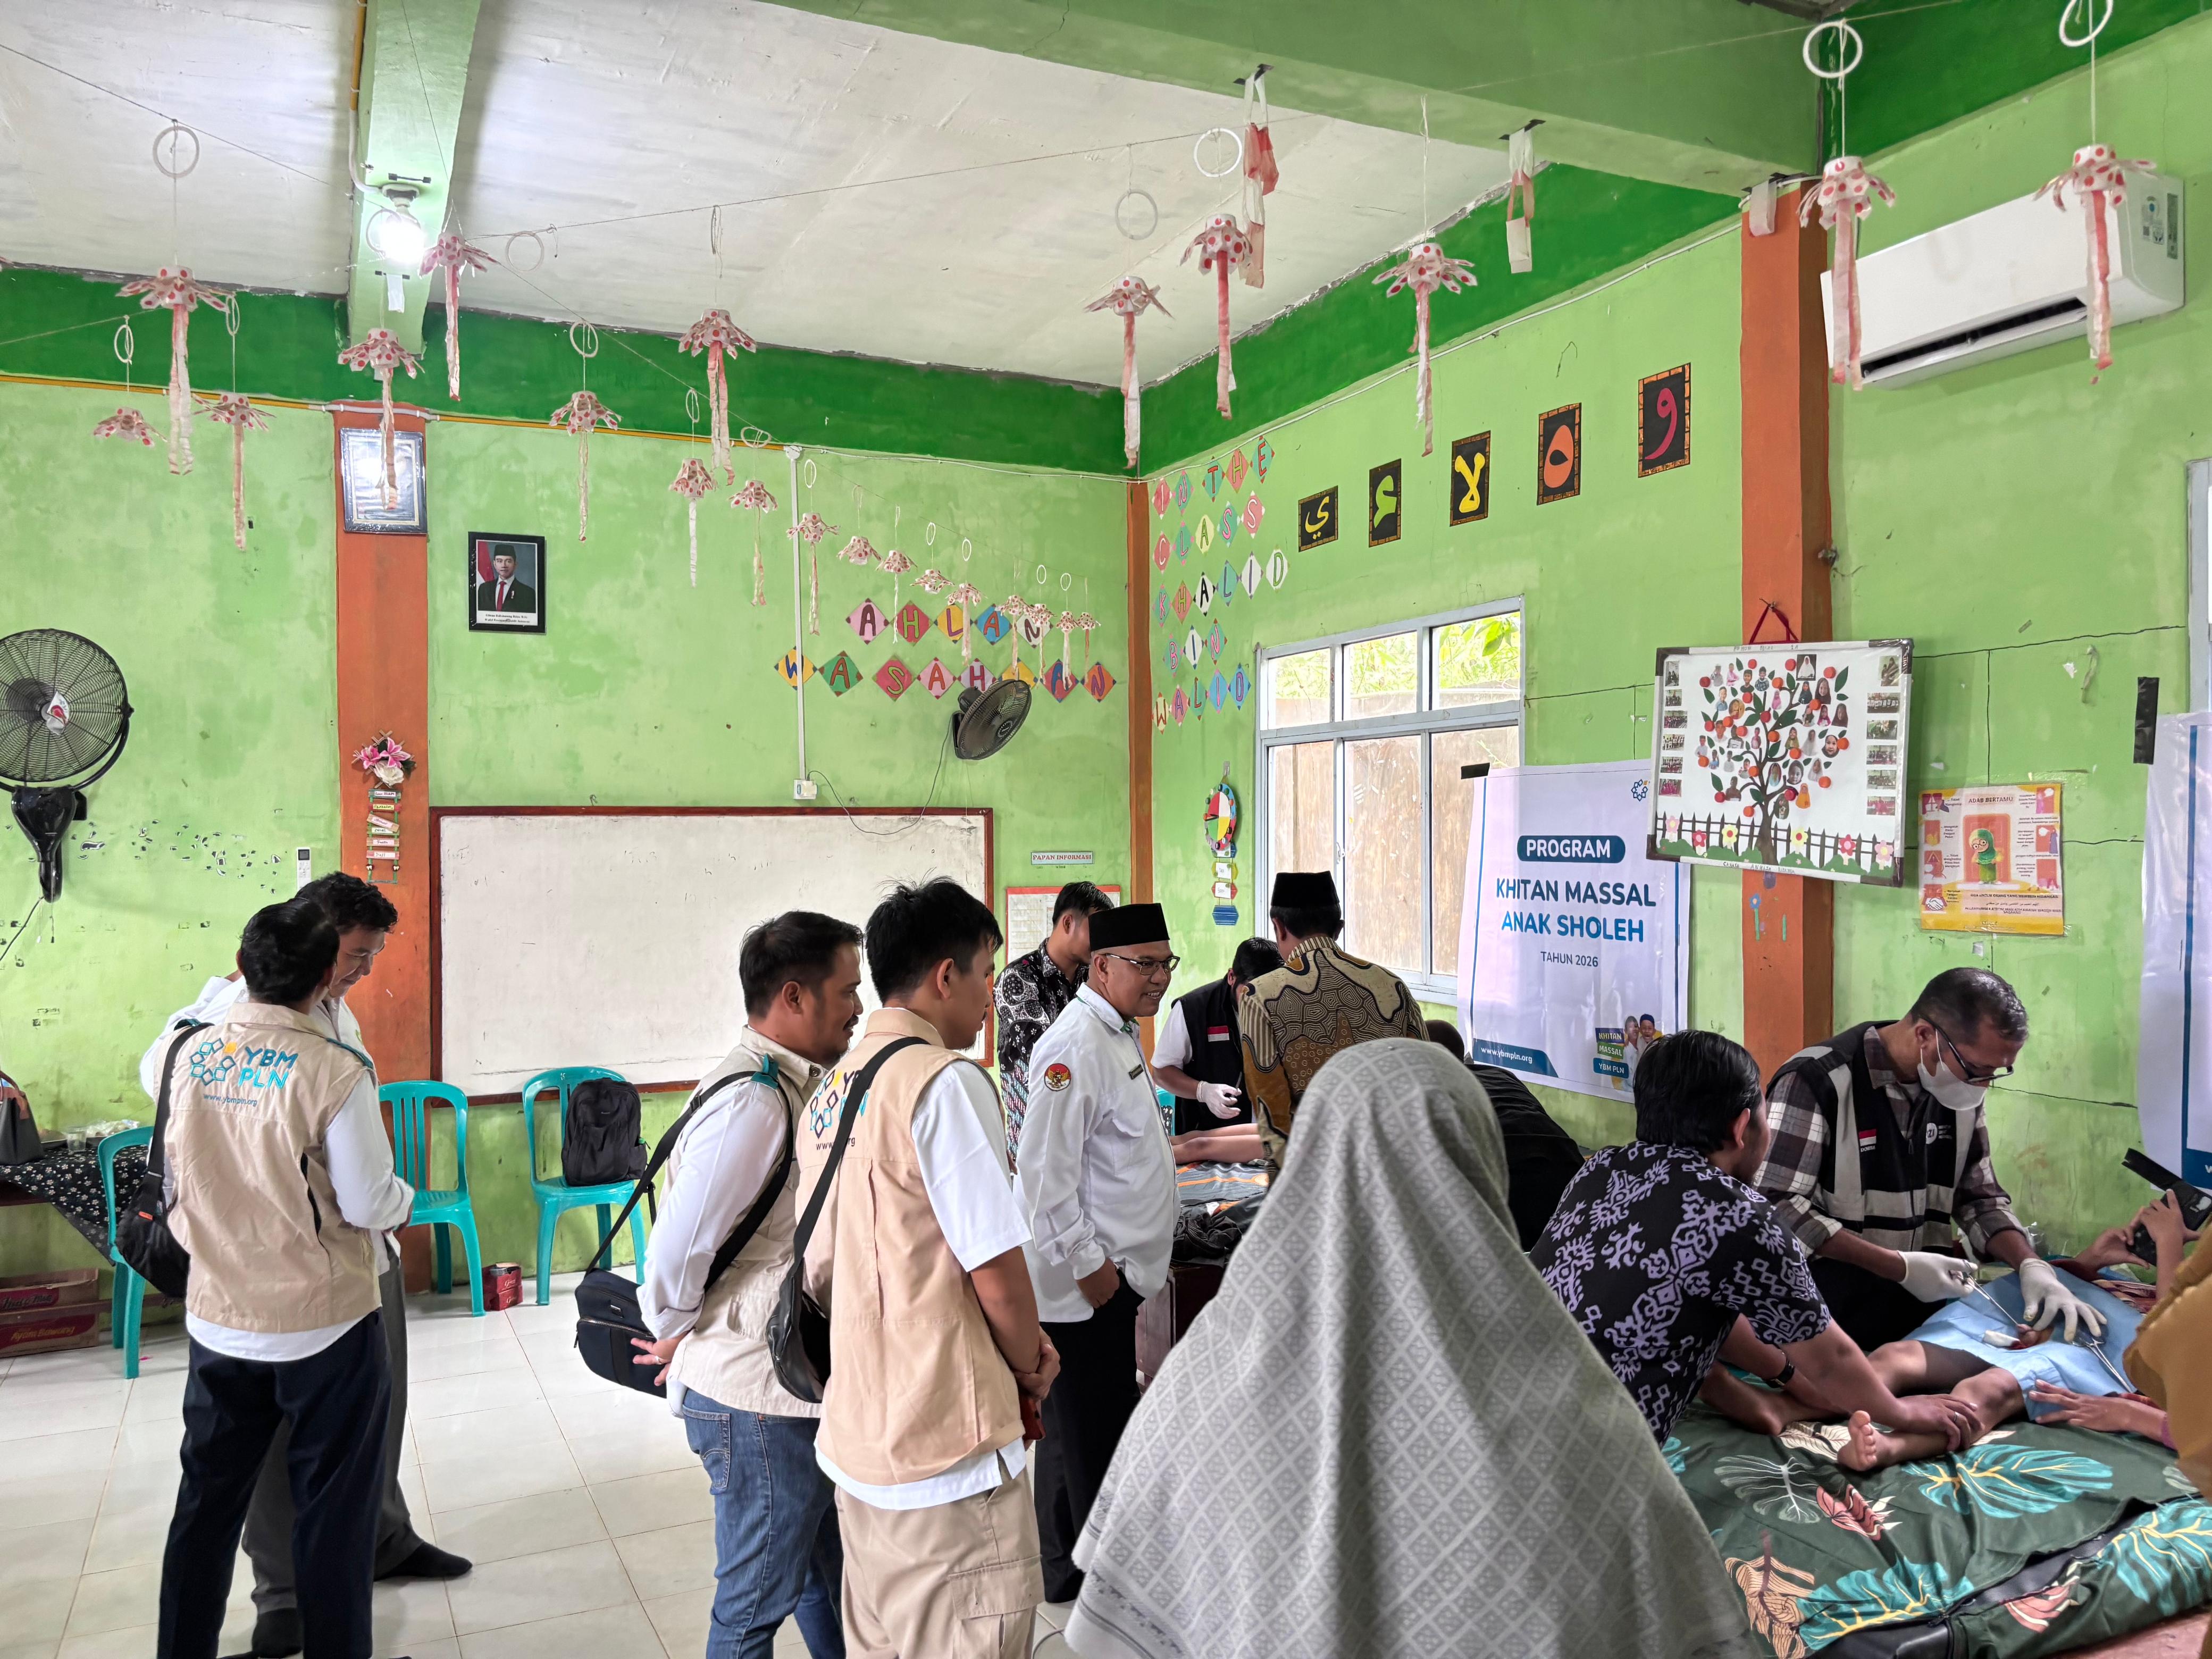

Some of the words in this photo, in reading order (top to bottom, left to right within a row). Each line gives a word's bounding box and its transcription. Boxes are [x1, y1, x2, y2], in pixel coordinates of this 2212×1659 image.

[1645, 388, 1677, 459] و
[1161, 484, 1187, 505] IN
[1208, 442, 1267, 494] THE
[1159, 499, 1257, 565] CLASS
[1159, 552, 1284, 619] KHALID
[860, 604, 1040, 640] AHLAN
[1170, 632, 1220, 669] BIN
[886, 662, 1105, 696] SAHAN
[1155, 673, 1244, 727] WALID
[1527, 840, 1610, 858] PROGRAM
[1496, 878, 1558, 902] KHITAN
[1565, 882, 1656, 907] MASSAL
[1502, 911, 1551, 934] ANAK
[1557, 915, 1644, 942] SHOLEH
[1540, 951, 1572, 965] TAHUN
[1576, 954, 1598, 967] 2026
[245, 1046, 298, 1069] YBM
[1481, 1047, 1532, 1064] www.ybmpln.org
[1599, 1045, 1622, 1056] MASSAL
[238, 1068, 289, 1089] PLN
